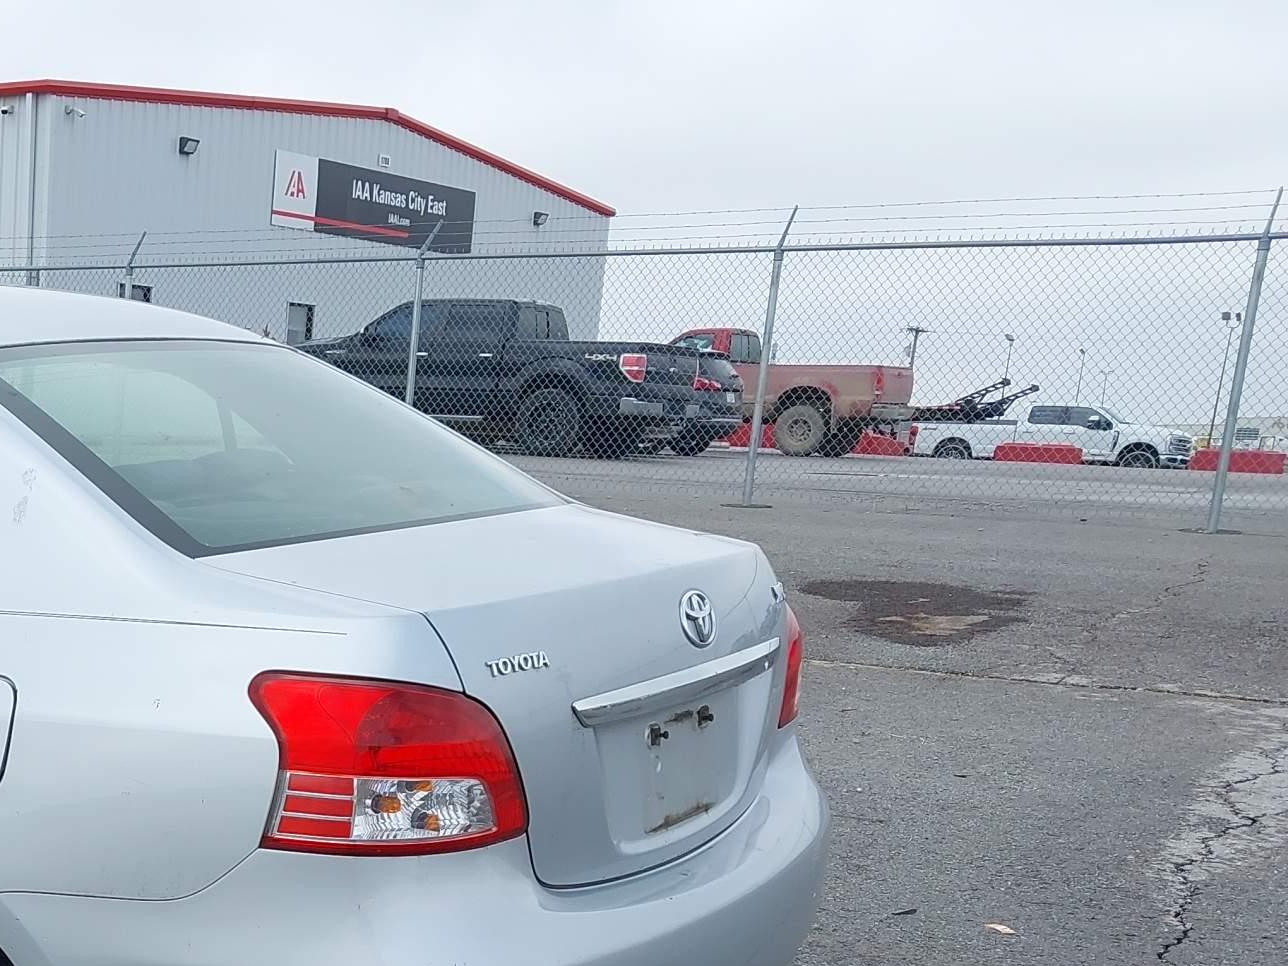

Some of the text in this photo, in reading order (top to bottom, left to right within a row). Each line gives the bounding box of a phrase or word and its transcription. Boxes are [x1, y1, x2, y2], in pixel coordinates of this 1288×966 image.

[352, 179, 447, 217] IAA Kansas City East
[485, 651, 550, 678] TOYOTA
